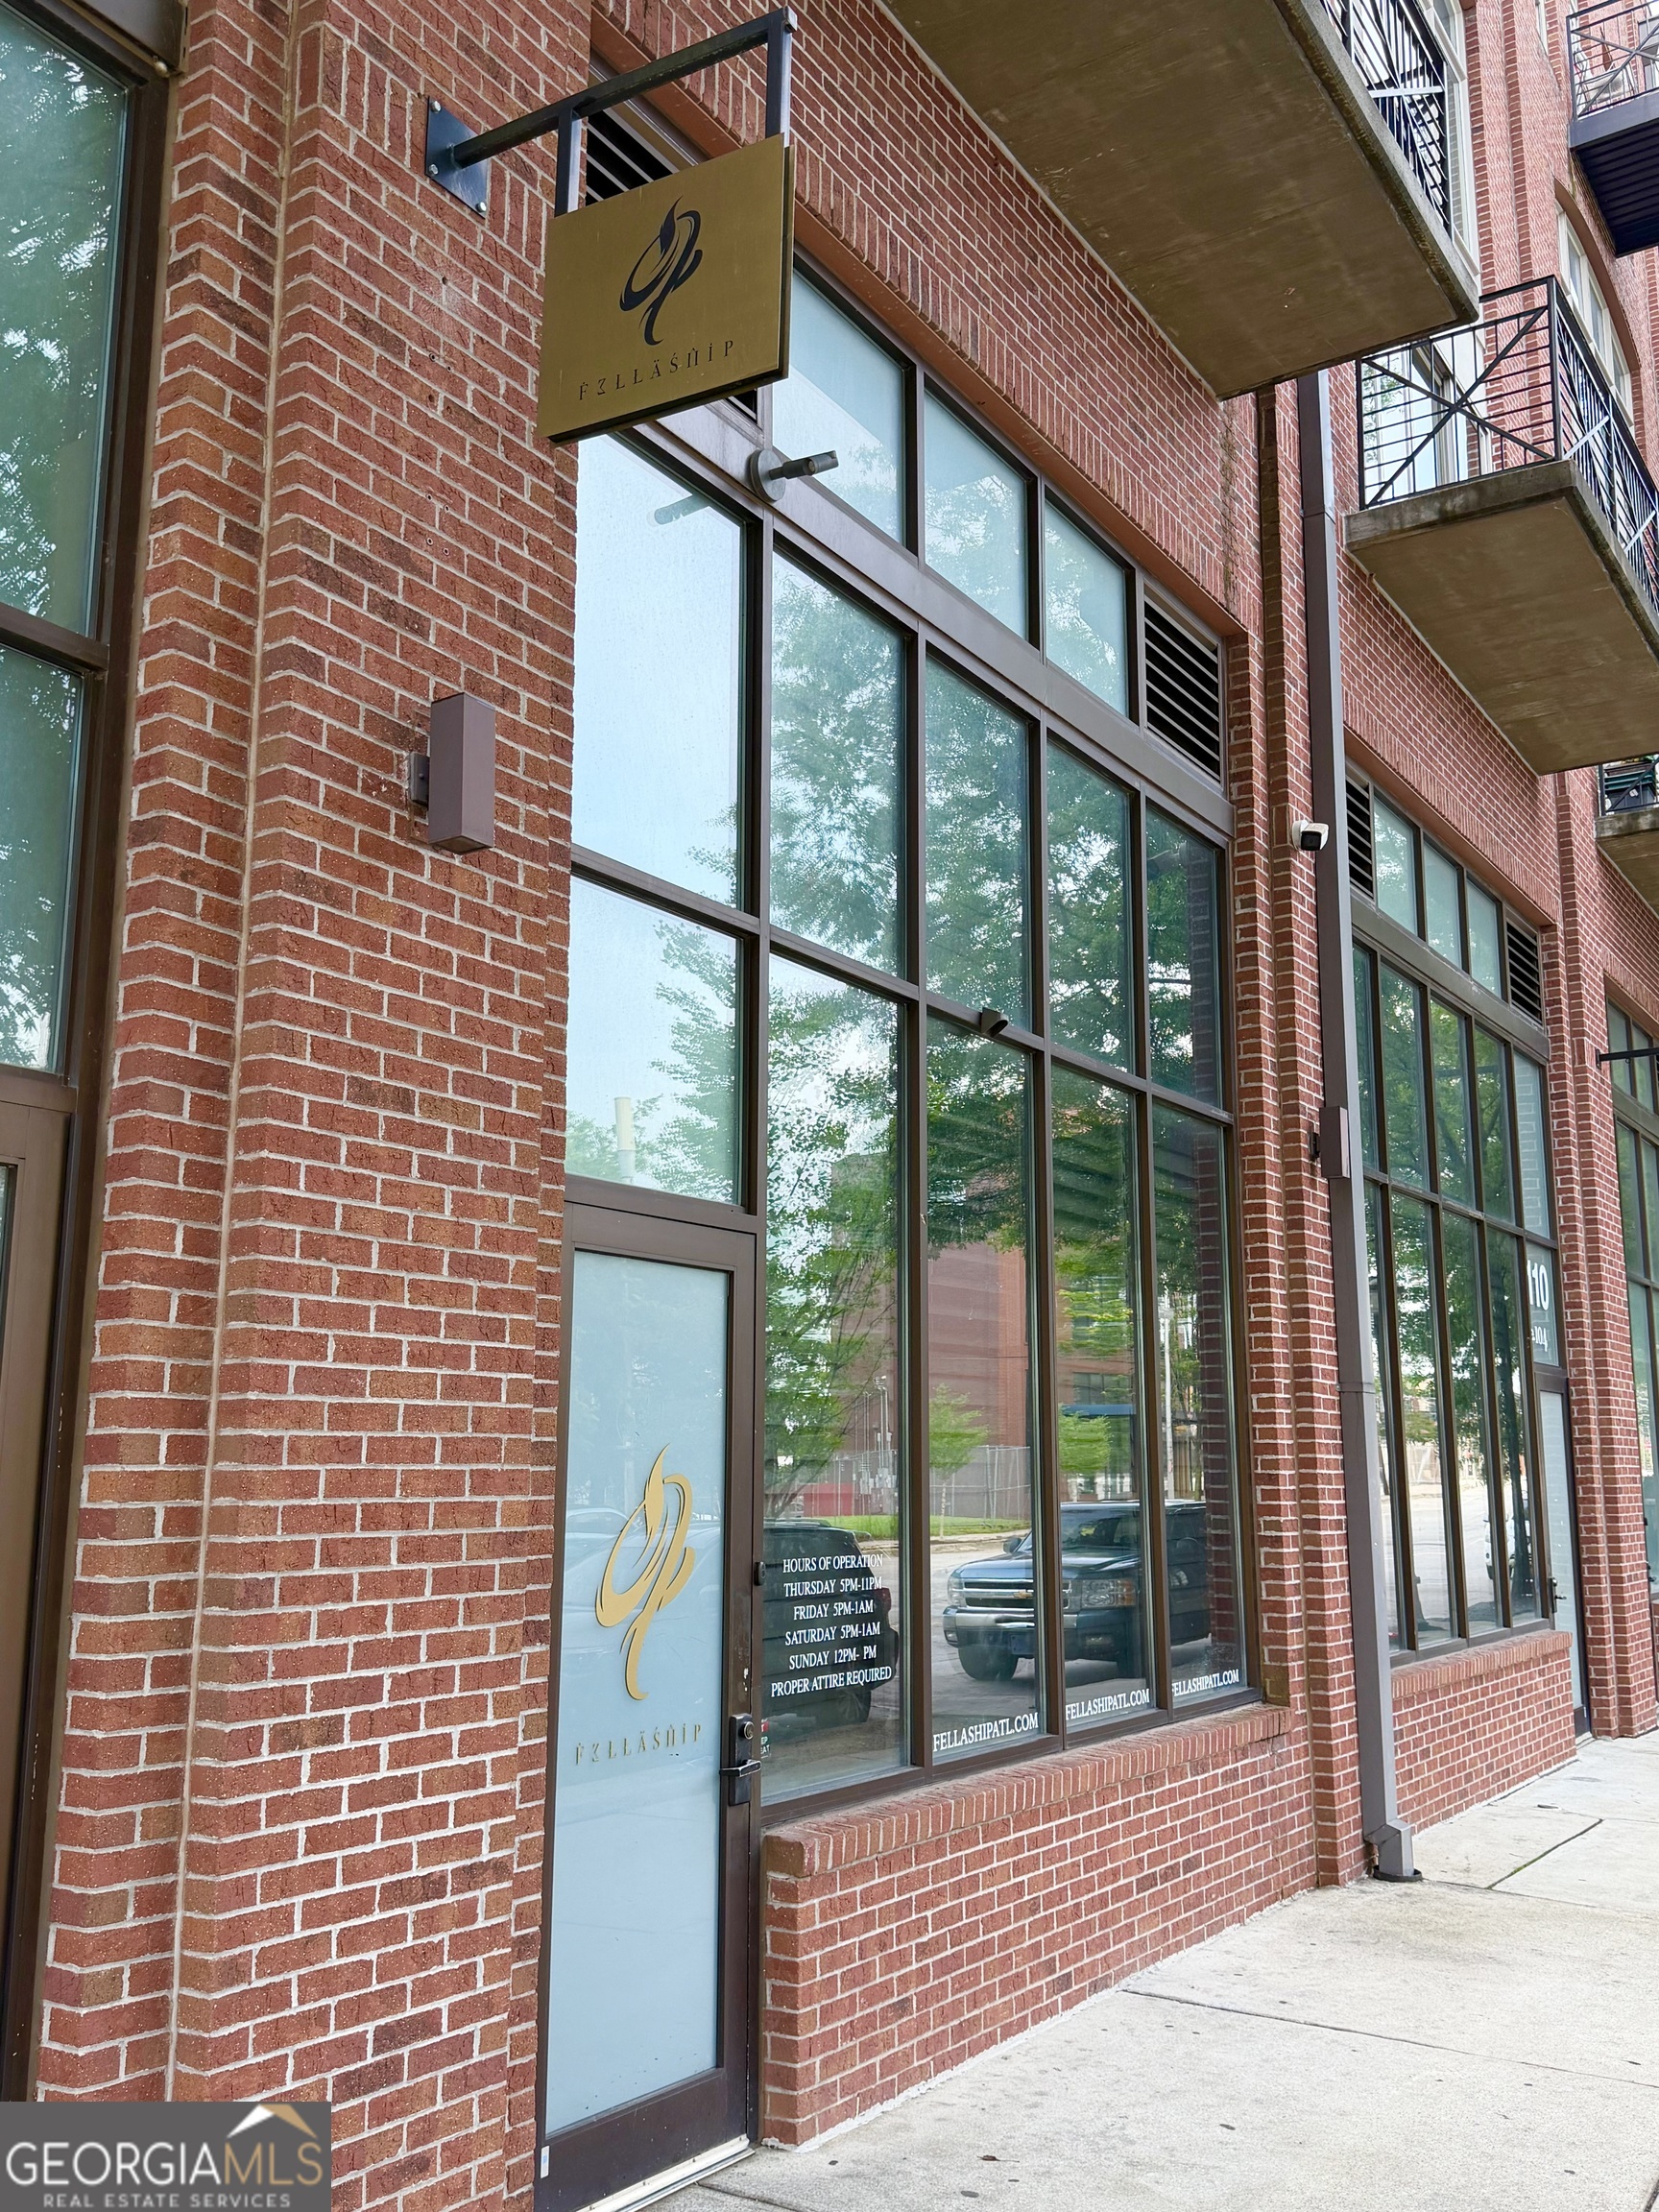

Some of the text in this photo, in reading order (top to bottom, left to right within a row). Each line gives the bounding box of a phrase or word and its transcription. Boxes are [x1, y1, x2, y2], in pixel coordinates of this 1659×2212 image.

[782, 1554, 883, 1573] HOURS OF OPERATION
[783, 1576, 882, 1597] THURSDAY 5PM-11PM
[793, 1599, 874, 1621] FRIDAY 5PM-1AM
[785, 1622, 880, 1646] SATURDAY 5PM-1AM
[789, 1651, 830, 1670] SUNDAY
[771, 1666, 892, 1697] PROPER ATTIRE REQUIRED
[1066, 1689, 1150, 1720] FELLASHIPATL.COM
[933, 1712, 1039, 1752] FELLASHIPATL.COM
